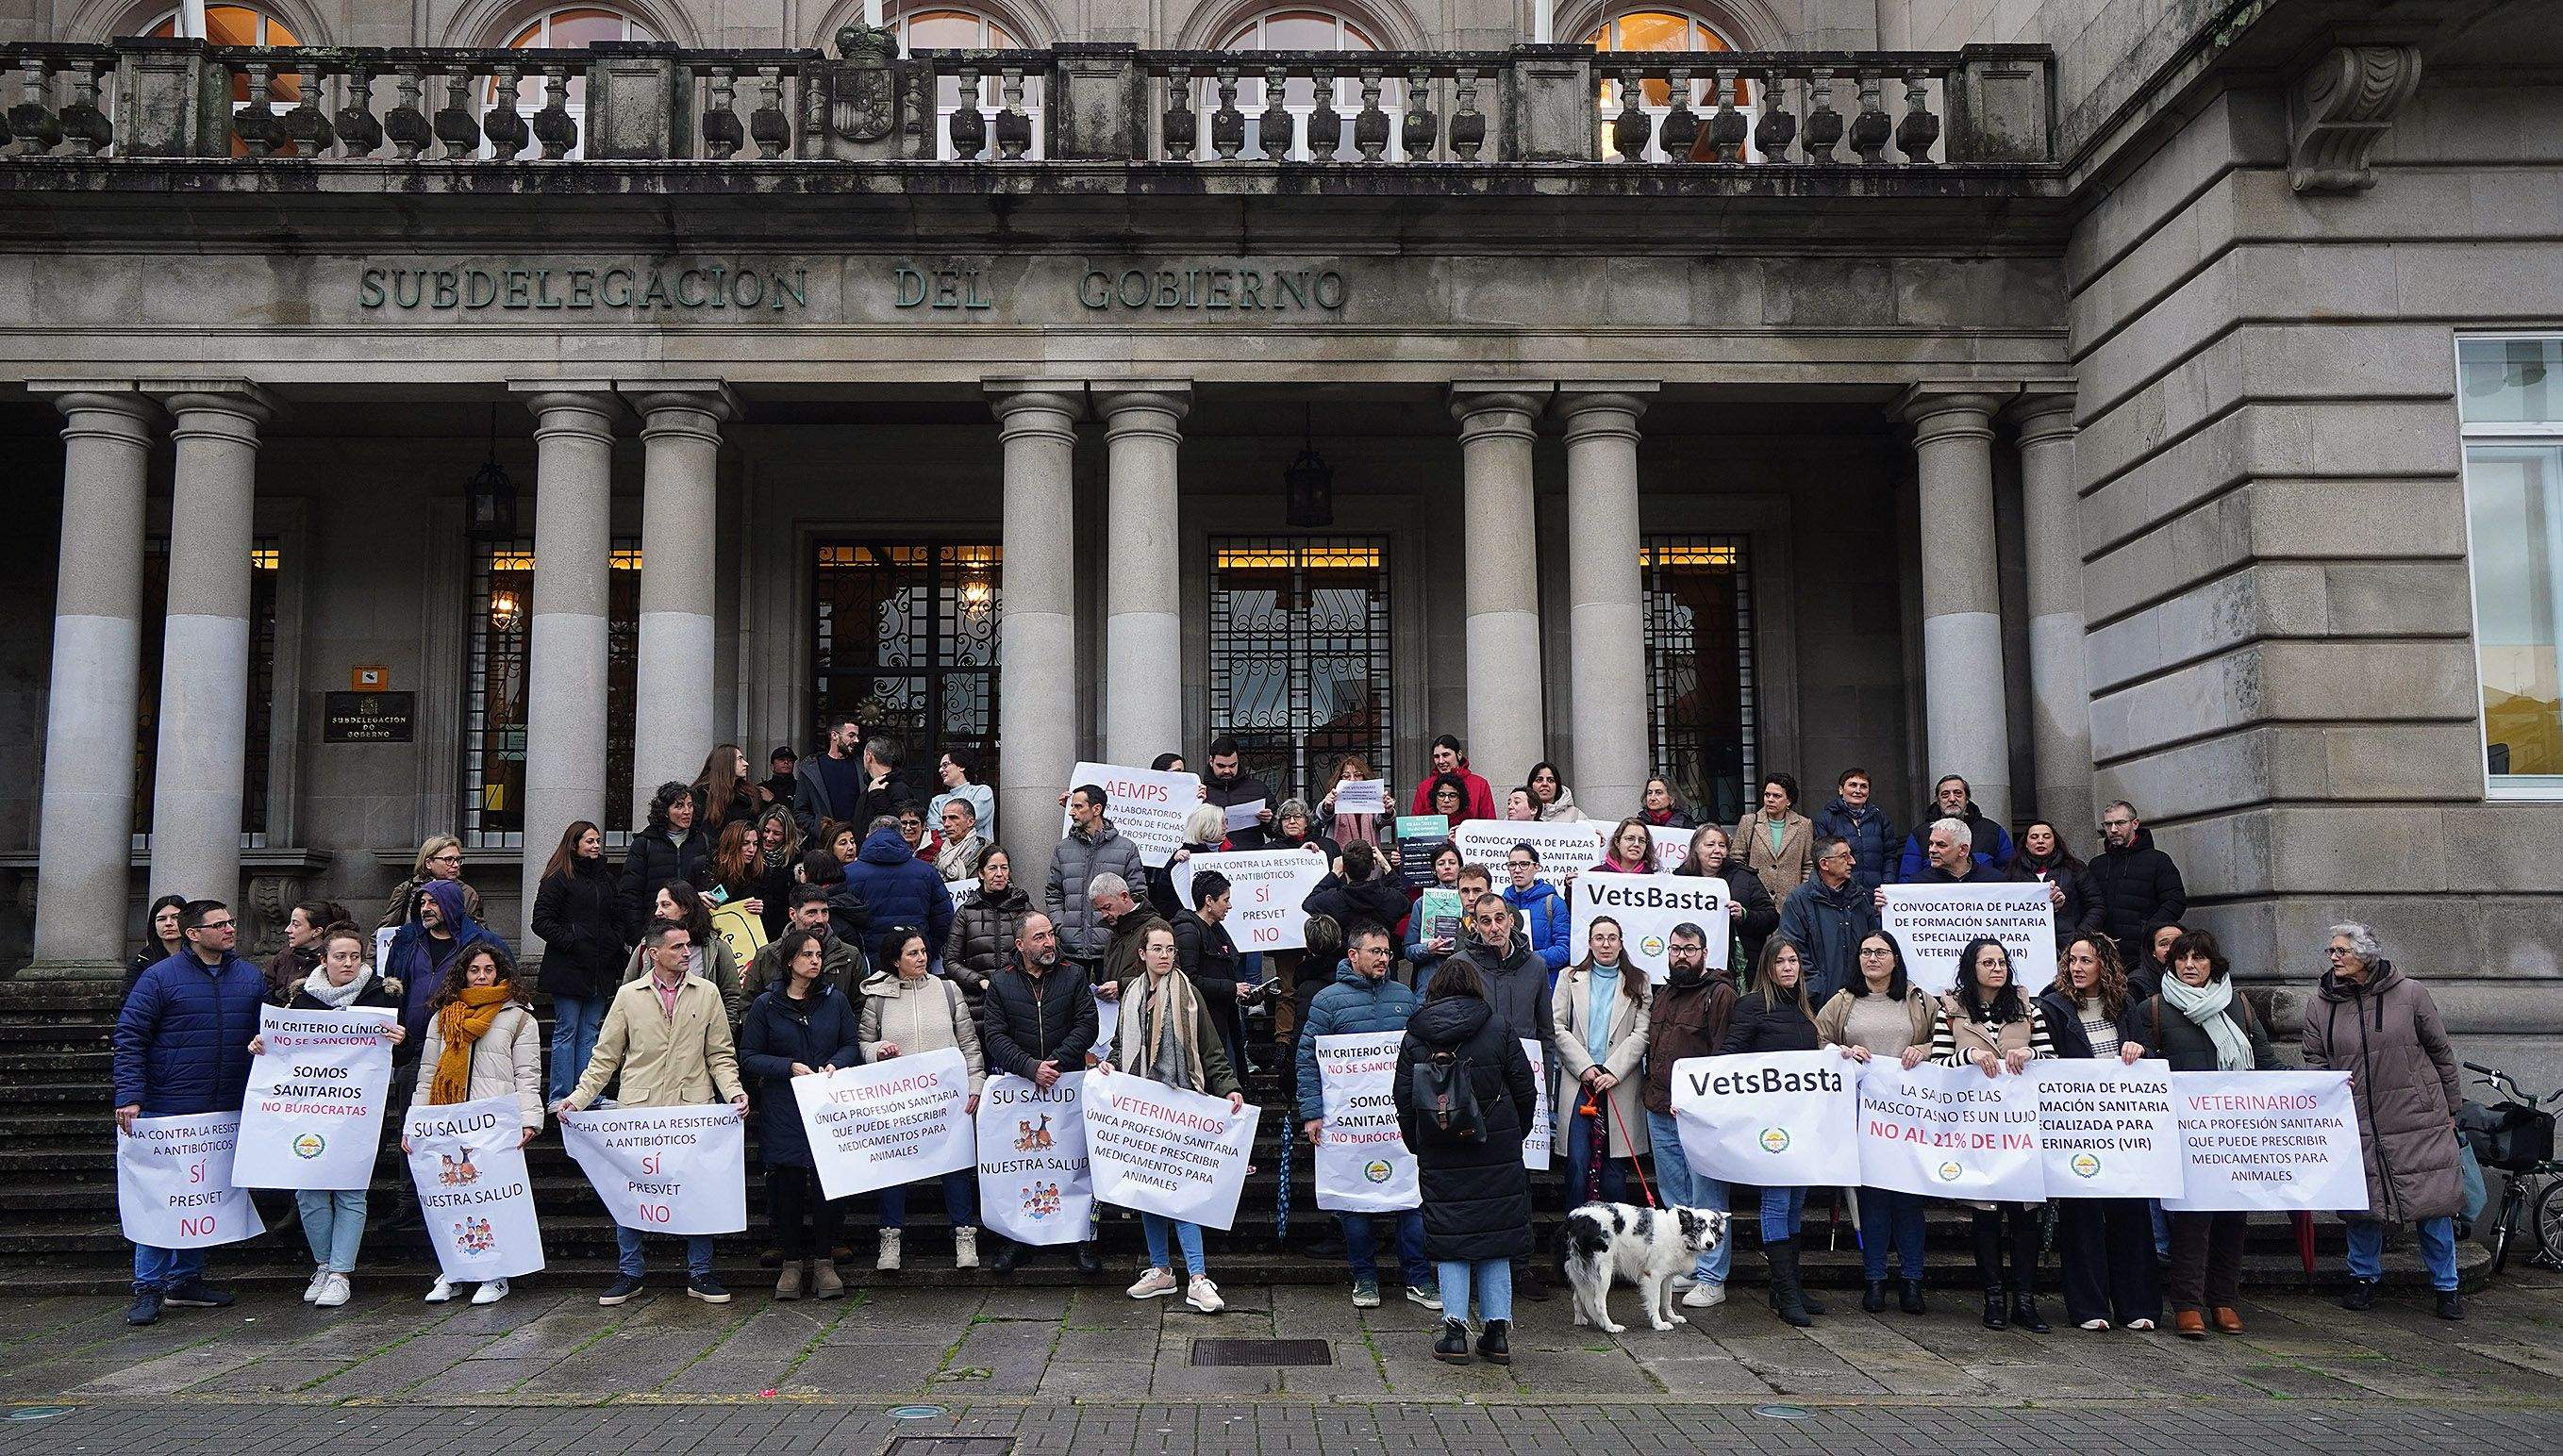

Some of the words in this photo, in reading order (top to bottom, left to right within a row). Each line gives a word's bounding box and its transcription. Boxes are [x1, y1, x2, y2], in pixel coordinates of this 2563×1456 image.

[358, 268, 807, 311] SUBDELEGACION
[894, 267, 991, 309] DEL
[1078, 269, 1349, 310] GOBIERNO
[1105, 780, 1169, 802] AEMPS
[1121, 805, 1182, 819] LABORATORIOS
[1157, 821, 1186, 833] FICHAS
[1122, 830, 1173, 842] PROSPECTOS
[1465, 835, 1542, 847] CONVOCATORIA
[1544, 838, 1556, 848] DE
[1559, 839, 1595, 848] PLAZAS
[1465, 848, 1477, 857] DE
[1542, 852, 1594, 861] SANITARIA
[1193, 862, 1223, 871] LUCHA
[1223, 860, 1259, 869] CONTRA
[1261, 859, 1272, 868] LA
[1273, 857, 1324, 867] RESISTENCIA
[1553, 865, 1579, 873] PARA
[1235, 870, 1295, 882] ANTIBIÓTICOS
[1256, 884, 1270, 902] SÍ
[1588, 884, 1718, 911] VetsBasta
[1242, 908, 1287, 920] PRESVET
[1892, 902, 1985, 913] CONVOCATORIA
[1987, 902, 2002, 912] DE
[2005, 902, 2047, 912] PLAZAS
[1894, 918, 1909, 928] DE
[1912, 915, 1982, 928] FORMACIÓN
[1985, 918, 2047, 928] SANITARIA
[1253, 927, 1280, 943] NO
[1912, 933, 1996, 942] ESPECIALIZADA
[1999, 933, 2031, 942] PARA
[1916, 947, 1962, 958] VETERIN
[264, 1018, 279, 1031] MI
[282, 1021, 339, 1034] CRITERIO
[341, 1022, 390, 1034] CLÍNICO
[274, 1035, 291, 1047] NO
[312, 1036, 377, 1047] SANCIONA
[1318, 1049, 1332, 1058] MI
[1333, 1046, 1381, 1059] CRITERIO
[1383, 1042, 1401, 1056] CLÍN
[292, 1066, 348, 1079] SOMOS
[1328, 1065, 1343, 1074] NO
[1345, 1064, 1359, 1074] SE
[828, 1072, 939, 1104] VETERINARIOS
[1689, 1067, 1842, 1097] VetsBasta
[2039, 1083, 2095, 1094] CATORIA
[2100, 1083, 2116, 1093] DE
[2120, 1083, 2168, 1094] PLAZAS
[273, 1084, 362, 1099] SANITARIOS
[992, 1090, 1014, 1105] SU
[1021, 1088, 1075, 1103] SALUD
[1900, 1084, 1917, 1098] LA
[1956, 1090, 1975, 1103] DE
[1978, 1090, 2002, 1103] LAS
[261, 1101, 281, 1113] NO
[284, 1102, 367, 1117] BURÓCRATAS
[814, 1110, 847, 1125] ÚNICA
[850, 1100, 906, 1119] PROFESIÓN
[907, 1089, 959, 1109] SANITARIA
[1350, 1094, 1396, 1109] SOMOS
[2039, 1099, 2094, 1112] MACIÓN
[2099, 1100, 2170, 1113] SANITARIA
[2189, 1095, 2318, 1111] VETERINARIOS
[1112, 1094, 1224, 1134] VETERINARIOS
[1938, 1111, 1959, 1123] NO
[1963, 1110, 1975, 1123] ES
[1978, 1111, 1999, 1123] UN
[2004, 1110, 2037, 1124] LUJO
[414, 1122, 433, 1137] SU
[437, 1113, 496, 1136] SALUD
[602, 1120, 650, 1132] CONTRA
[653, 1119, 667, 1129] LA
[670, 1116, 740, 1129] RESISTENCIA
[832, 1126, 853, 1138] QUE
[856, 1119, 890, 1133] PUEDE
[893, 1107, 948, 1128] PRESCRIBIR
[2117, 1119, 2154, 1131] PARA
[2178, 1118, 2207, 1130] NICA
[2210, 1117, 2277, 1130] PROFESIÓN
[2280, 1117, 2344, 1129] SANITARIA
[148, 1128, 196, 1140] CONTRA
[199, 1126, 210, 1136] LA
[212, 1122, 240, 1134] RESIST
[838, 1129, 920, 1153] MEDICAMENTOS
[922, 1123, 947, 1137] PARA
[1086, 1108, 1119, 1127] ÚNICA
[1121, 1118, 1182, 1143] PROFESIÓN
[1184, 1135, 1240, 1158] SANITARIA
[1331, 1133, 1348, 1143] NO
[1351, 1131, 1404, 1144] BURÓCRA
[1870, 1120, 1899, 1139] NO
[1904, 1127, 1929, 1146] AL
[1934, 1132, 1967, 1149] 21%
[1972, 1133, 1995, 1150] DE
[2002, 1133, 2034, 1150] IVA
[153, 1146, 162, 1156] A
[164, 1139, 233, 1156] ANTIBIÓTICOS
[606, 1138, 614, 1148] A
[616, 1133, 697, 1148] ANTIBIÓTICOS
[2119, 1137, 2152, 1151] (VIR)
[2188, 1136, 2215, 1149] QUE
[2218, 1136, 2258, 1147] PUEDE
[2262, 1134, 2328, 1147] PRESCRIBIR
[870, 1144, 919, 1164] ANIMALES
[1096, 1129, 1120, 1143] QUE
[1122, 1136, 1158, 1154] PUEDE
[1159, 1146, 1220, 1169] PRESCRIBIR
[642, 1152, 661, 1175] SÍ
[981, 1157, 1044, 1174] NUESTRA
[1048, 1157, 1090, 1171] SALUD
[1094, 1146, 1183, 1177] MEDICAMENTOS
[1185, 1168, 1214, 1184] PARA
[2191, 1153, 2291, 1165] MEDICAMENTOS
[2294, 1152, 2329, 1164] PARA
[190, 1158, 207, 1183] SÍ
[2231, 1170, 2292, 1182] ANIMALES
[628, 1181, 682, 1196] PRESVET
[1122, 1170, 1177, 1192] ANIMALES
[169, 1190, 223, 1207] PRESVET
[419, 1192, 473, 1208] NUESTRA
[474, 1183, 524, 1204] SALUD
[640, 1203, 671, 1223] NO
[180, 1216, 216, 1237] NO
